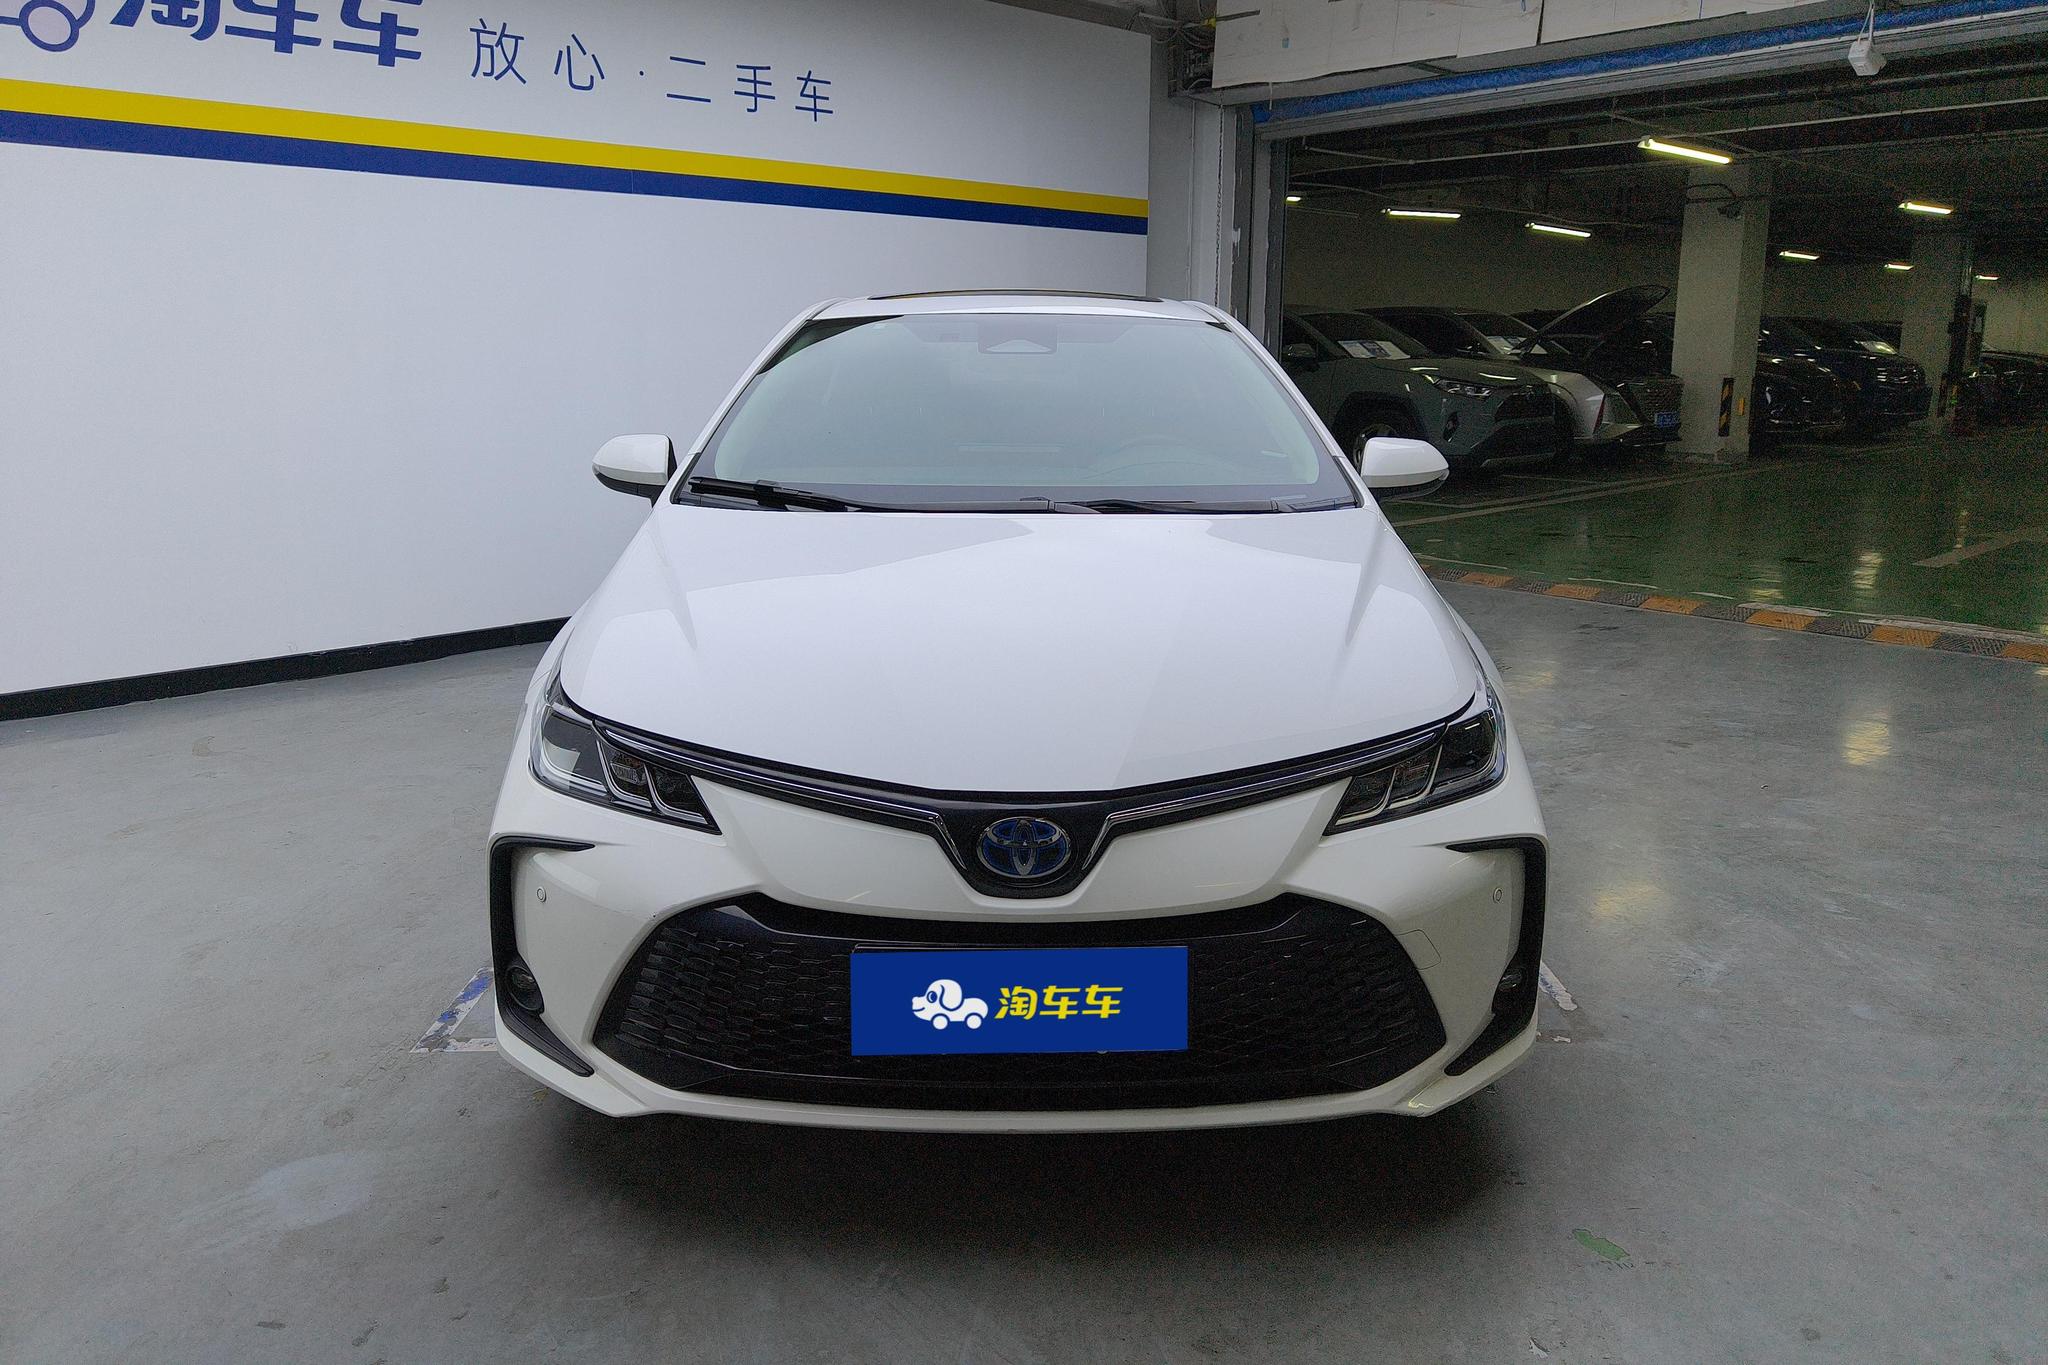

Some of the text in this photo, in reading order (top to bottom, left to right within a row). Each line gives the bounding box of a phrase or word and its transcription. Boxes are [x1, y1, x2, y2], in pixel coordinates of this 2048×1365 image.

[469, 18, 834, 122] 放心·二手车
